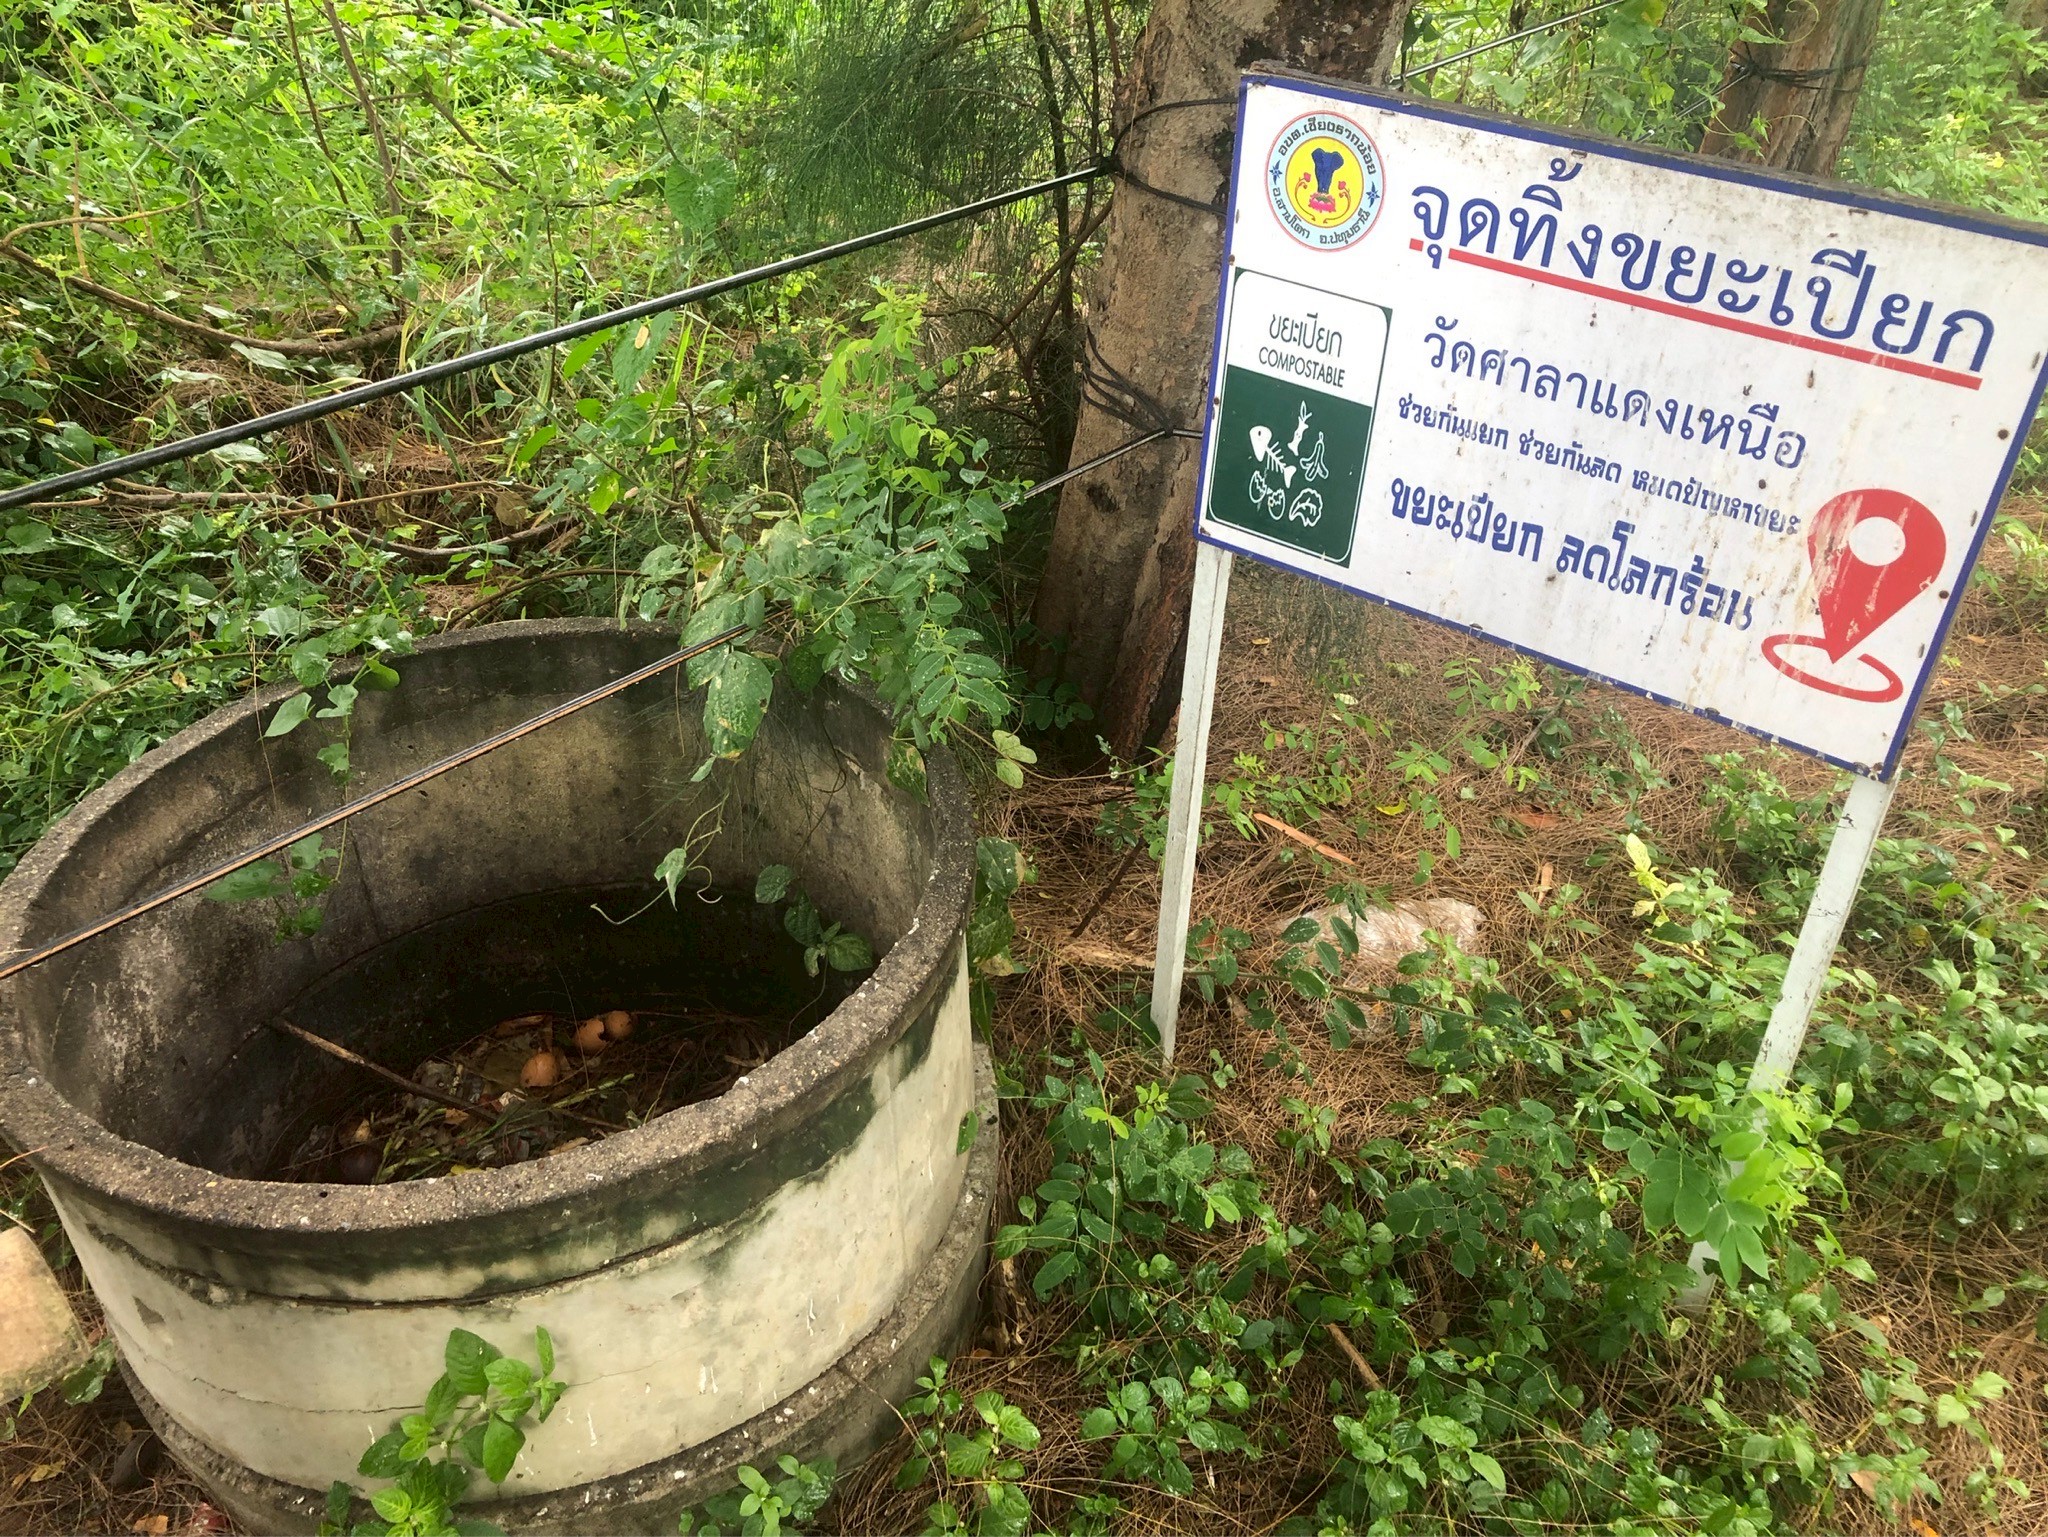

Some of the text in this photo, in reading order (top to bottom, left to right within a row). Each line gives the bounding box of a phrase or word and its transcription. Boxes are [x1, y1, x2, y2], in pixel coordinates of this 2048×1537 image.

[1269, 312, 1343, 358] ขยะเปียก
[1411, 157, 1997, 373] จุดทิ้งขยะเปียก
[1259, 346, 1346, 388] COMPOSTABLE
[1424, 315, 1807, 469] วัดศาลาแดงเหนือ
[1398, 393, 1802, 536] ช่วยกันแยก ช่วยกันลด หมดปัญหาขยะ
[1391, 477, 1755, 631] ขยะเปียก ลดโลกร้อน
